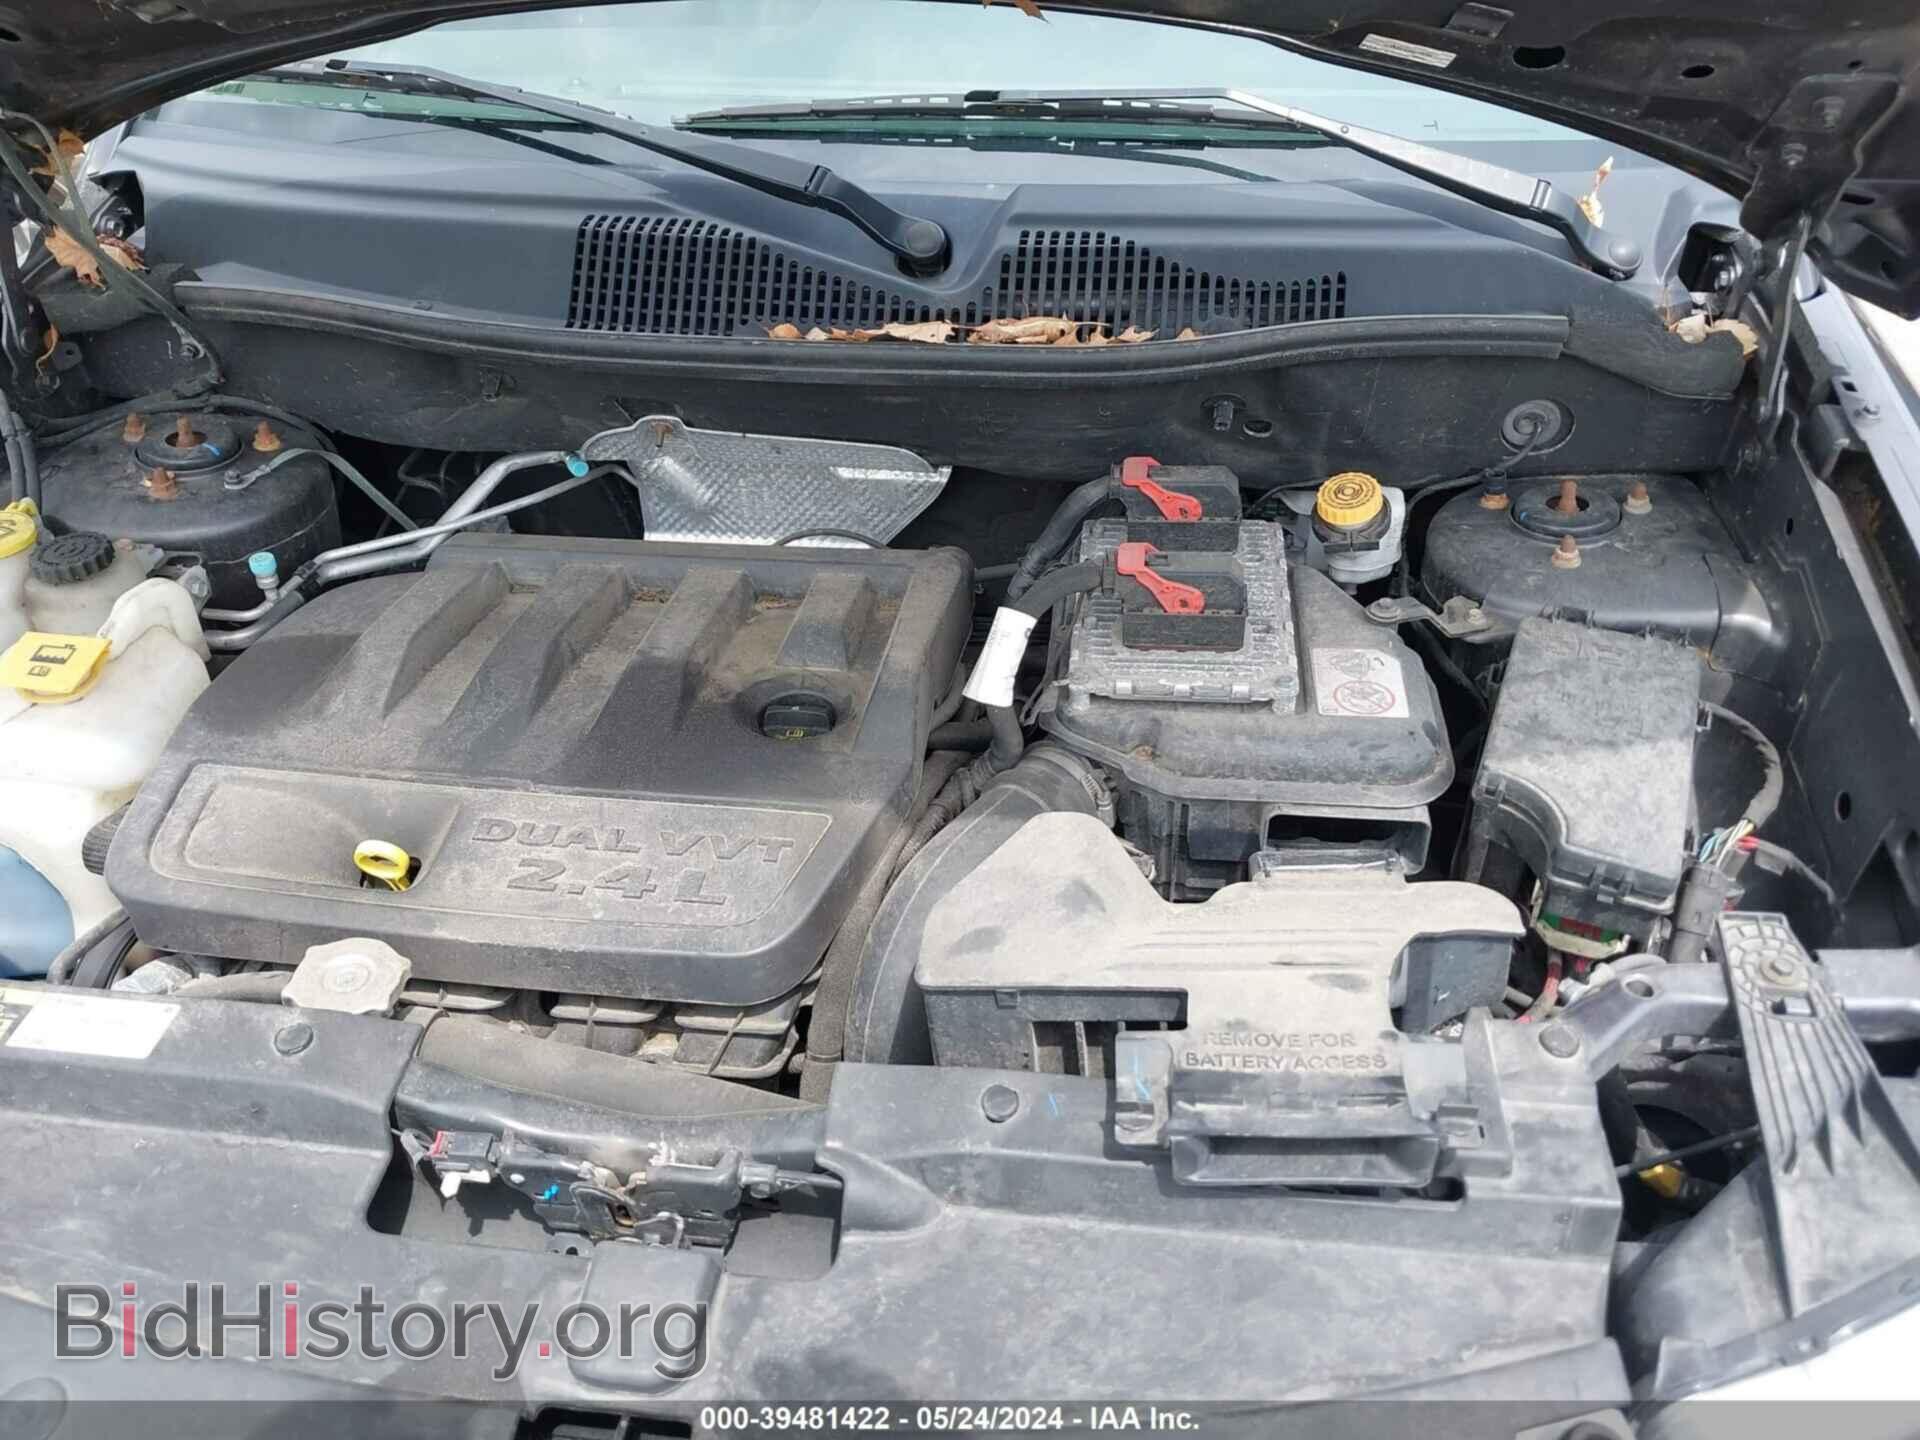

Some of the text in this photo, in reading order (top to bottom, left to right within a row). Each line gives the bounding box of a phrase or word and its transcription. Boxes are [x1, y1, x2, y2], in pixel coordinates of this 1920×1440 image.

[472, 817, 795, 863] DUAL VVT
[507, 858, 728, 906] 2.4L
[1202, 1031, 1357, 1048] REMOVE FOR
[1186, 1051, 1388, 1071] BATTERY ACCESS
